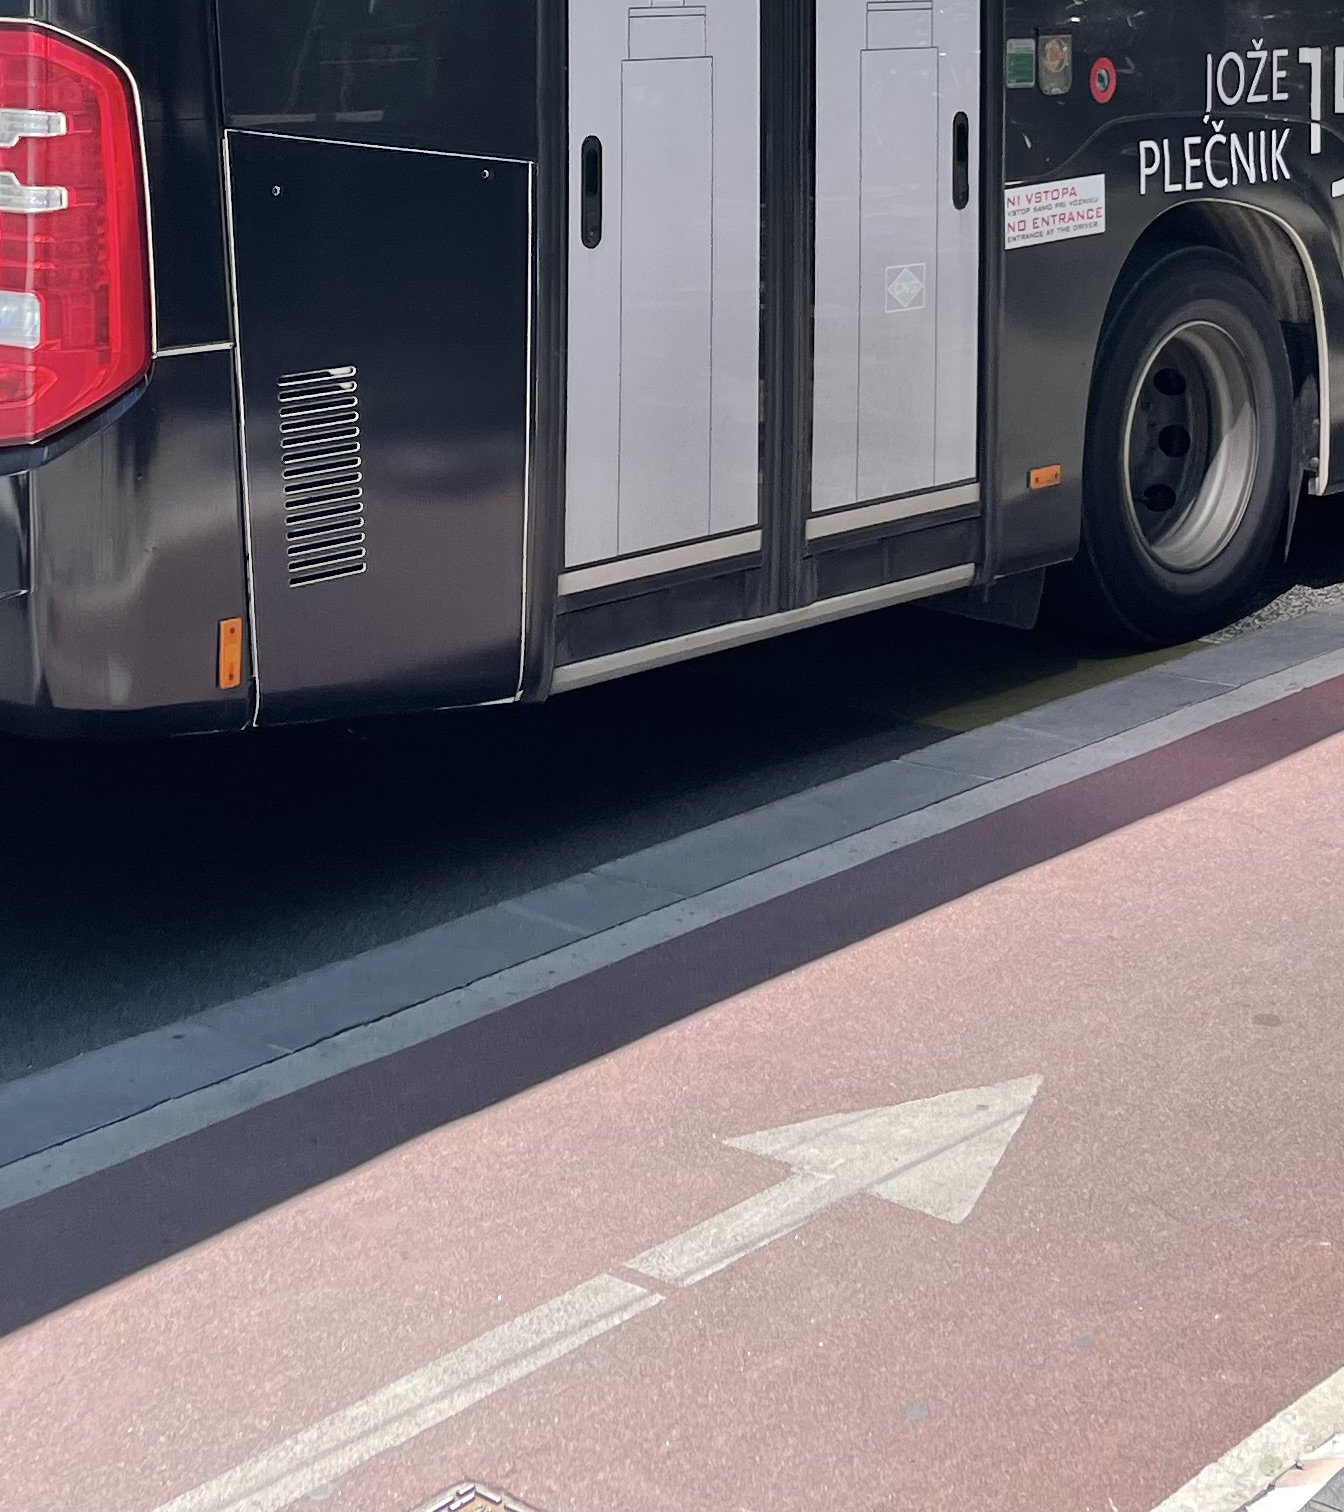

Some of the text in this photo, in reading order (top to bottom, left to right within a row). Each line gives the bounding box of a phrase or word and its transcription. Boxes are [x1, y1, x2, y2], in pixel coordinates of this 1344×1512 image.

[1203, 38, 1289, 125] JOŽE
[1138, 120, 1290, 195] PLEČNIK
[1007, 186, 1077, 209] NI VSTOPA
[1007, 207, 1103, 233] NO ENTRANCE
[1007, 221, 1098, 243] ENTRANCE AT THE DRIVER
